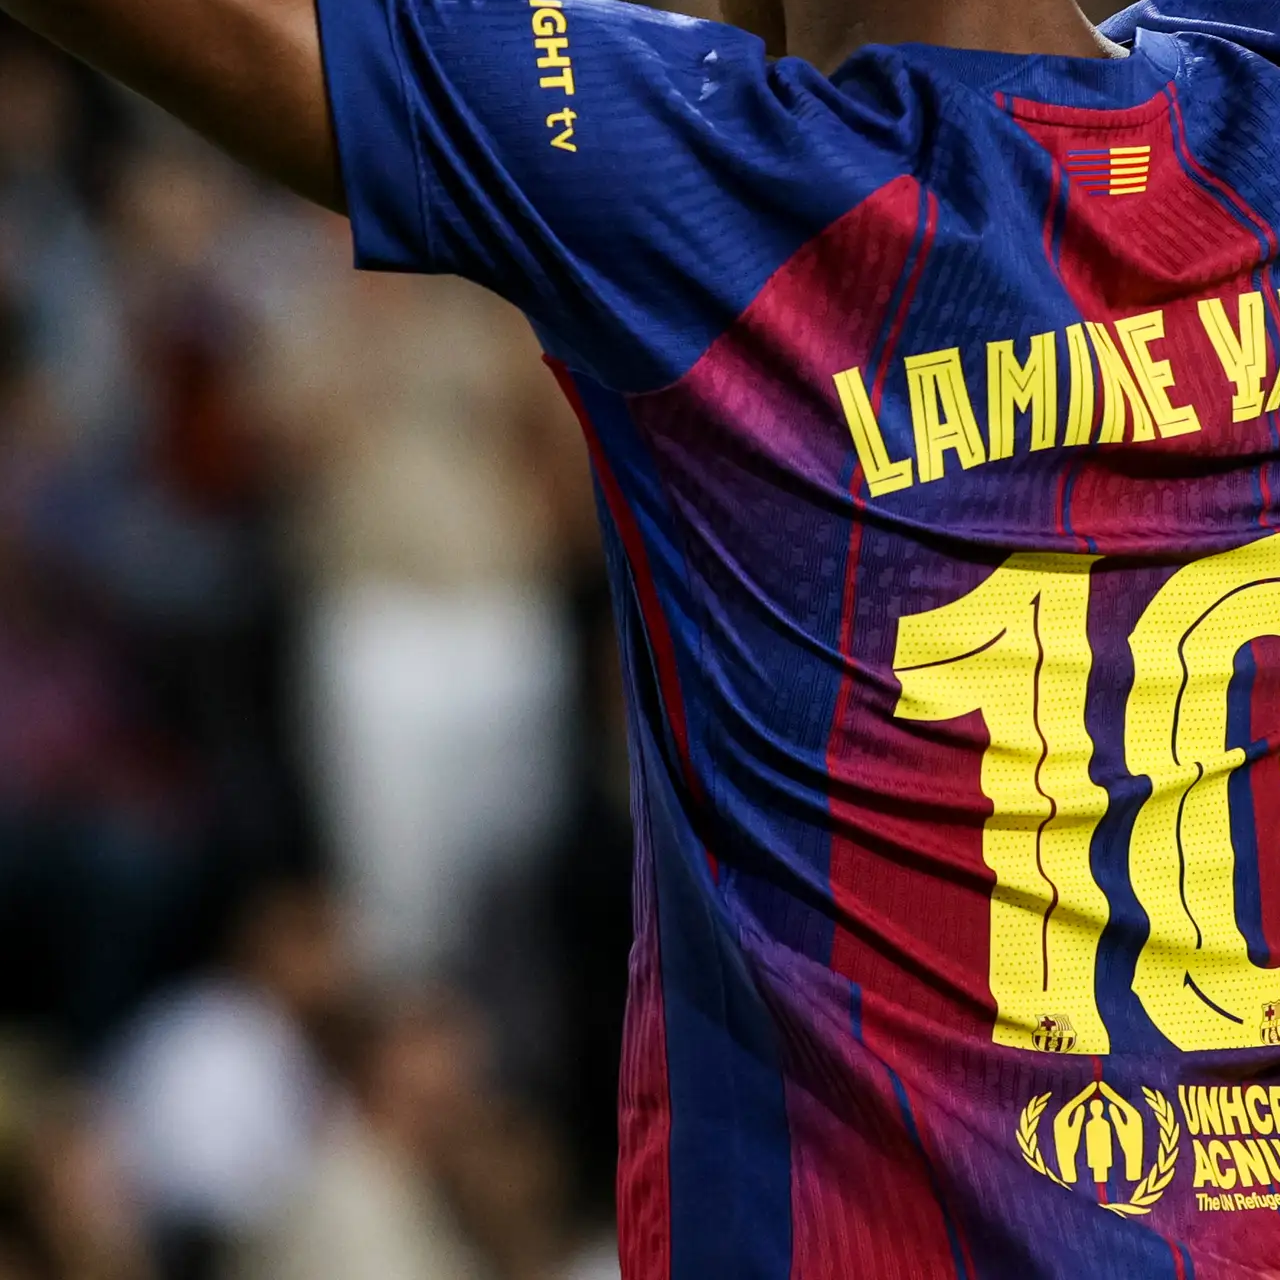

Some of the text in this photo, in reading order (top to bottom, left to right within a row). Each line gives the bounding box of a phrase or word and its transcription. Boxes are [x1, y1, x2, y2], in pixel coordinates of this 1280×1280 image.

[546, 108, 578, 152] tv
[833, 310, 1202, 498] LAMINE
[1195, 1192, 1221, 1212] The
